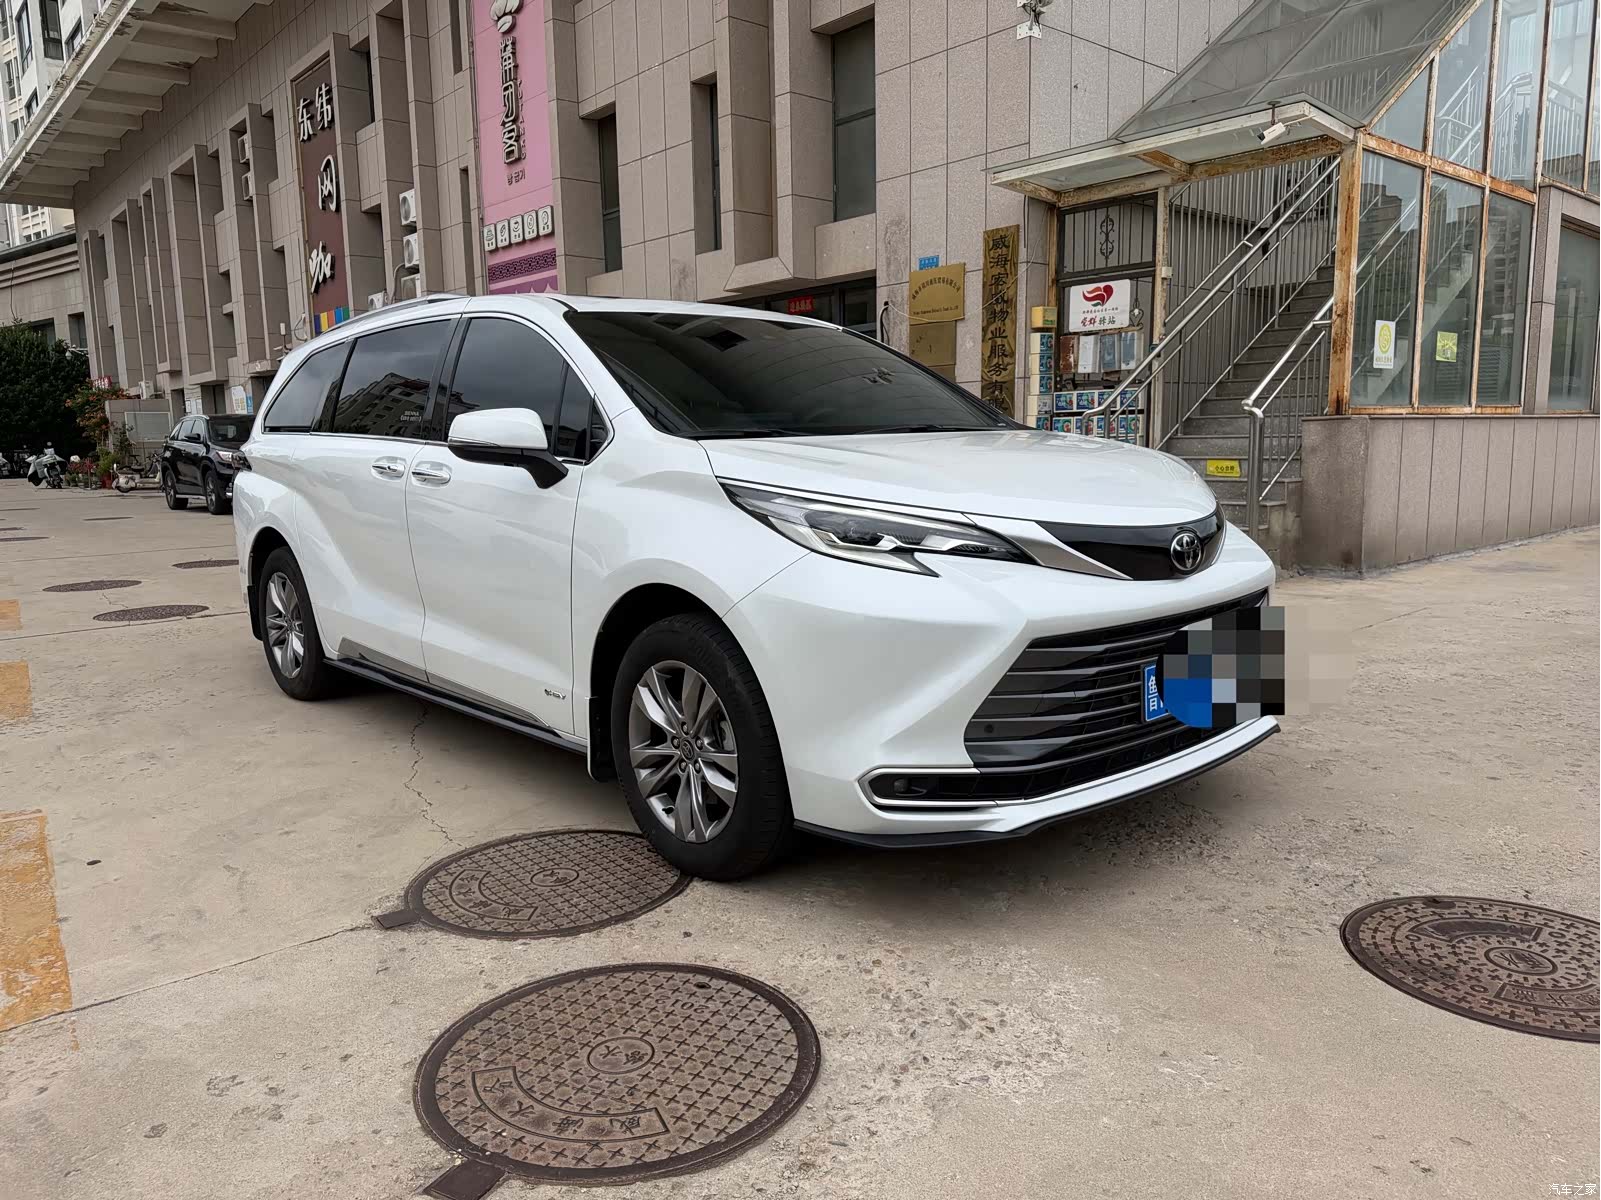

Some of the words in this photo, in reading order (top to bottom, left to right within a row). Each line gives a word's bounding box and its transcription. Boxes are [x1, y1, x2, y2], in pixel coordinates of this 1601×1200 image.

[297, 83, 333, 141] 东纬
[1148, 675, 1164, 712] 鲁
[655, 995, 710, 1014] 2012
